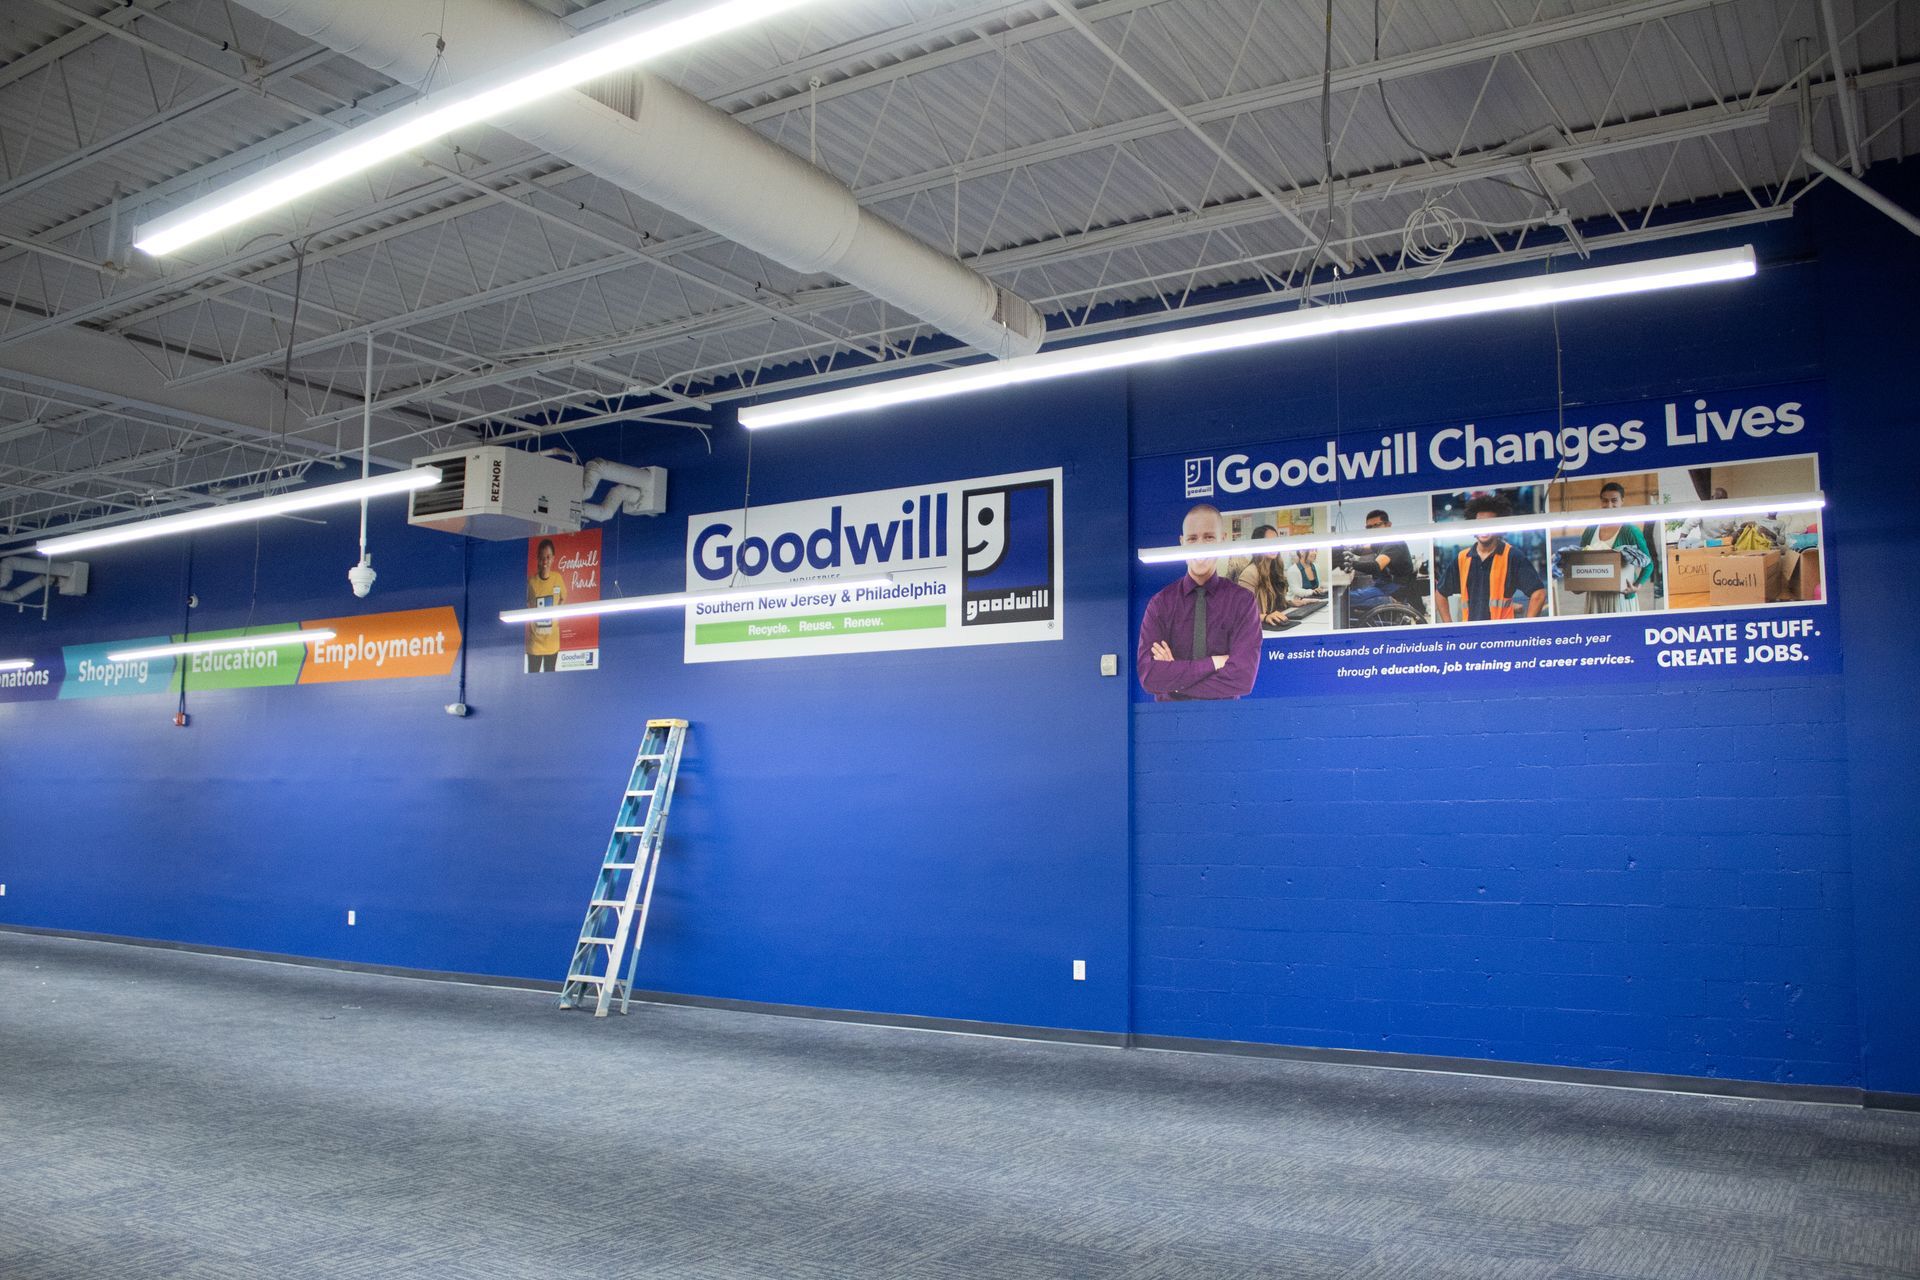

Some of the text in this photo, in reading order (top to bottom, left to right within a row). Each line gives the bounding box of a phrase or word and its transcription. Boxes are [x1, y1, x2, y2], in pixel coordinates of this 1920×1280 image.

[1216, 399, 1805, 493] Goodwill Changes Lives
[491, 460, 502, 502] REZNOR
[693, 492, 948, 581] Goodwill
[558, 550, 598, 572] Goodwill
[1713, 569, 1757, 588] Goodwill
[696, 581, 946, 615] Southern New Jersey & Philadelphia
[966, 589, 1049, 621] goodwill
[748, 616, 884, 636] Recycle. Reuse. Renew.
[1644, 619, 1821, 645] DONATE STUFF.
[191, 645, 277, 673] Education
[313, 630, 445, 669] Employment
[1268, 633, 1612, 661] We assist thousands of individuals in our communities each year
[1656, 643, 1809, 668] CREATE JOBS.
[0, 667, 49, 688] nations
[78, 660, 149, 686] Shopping
[1337, 654, 1635, 679] through education, job training and career services.
